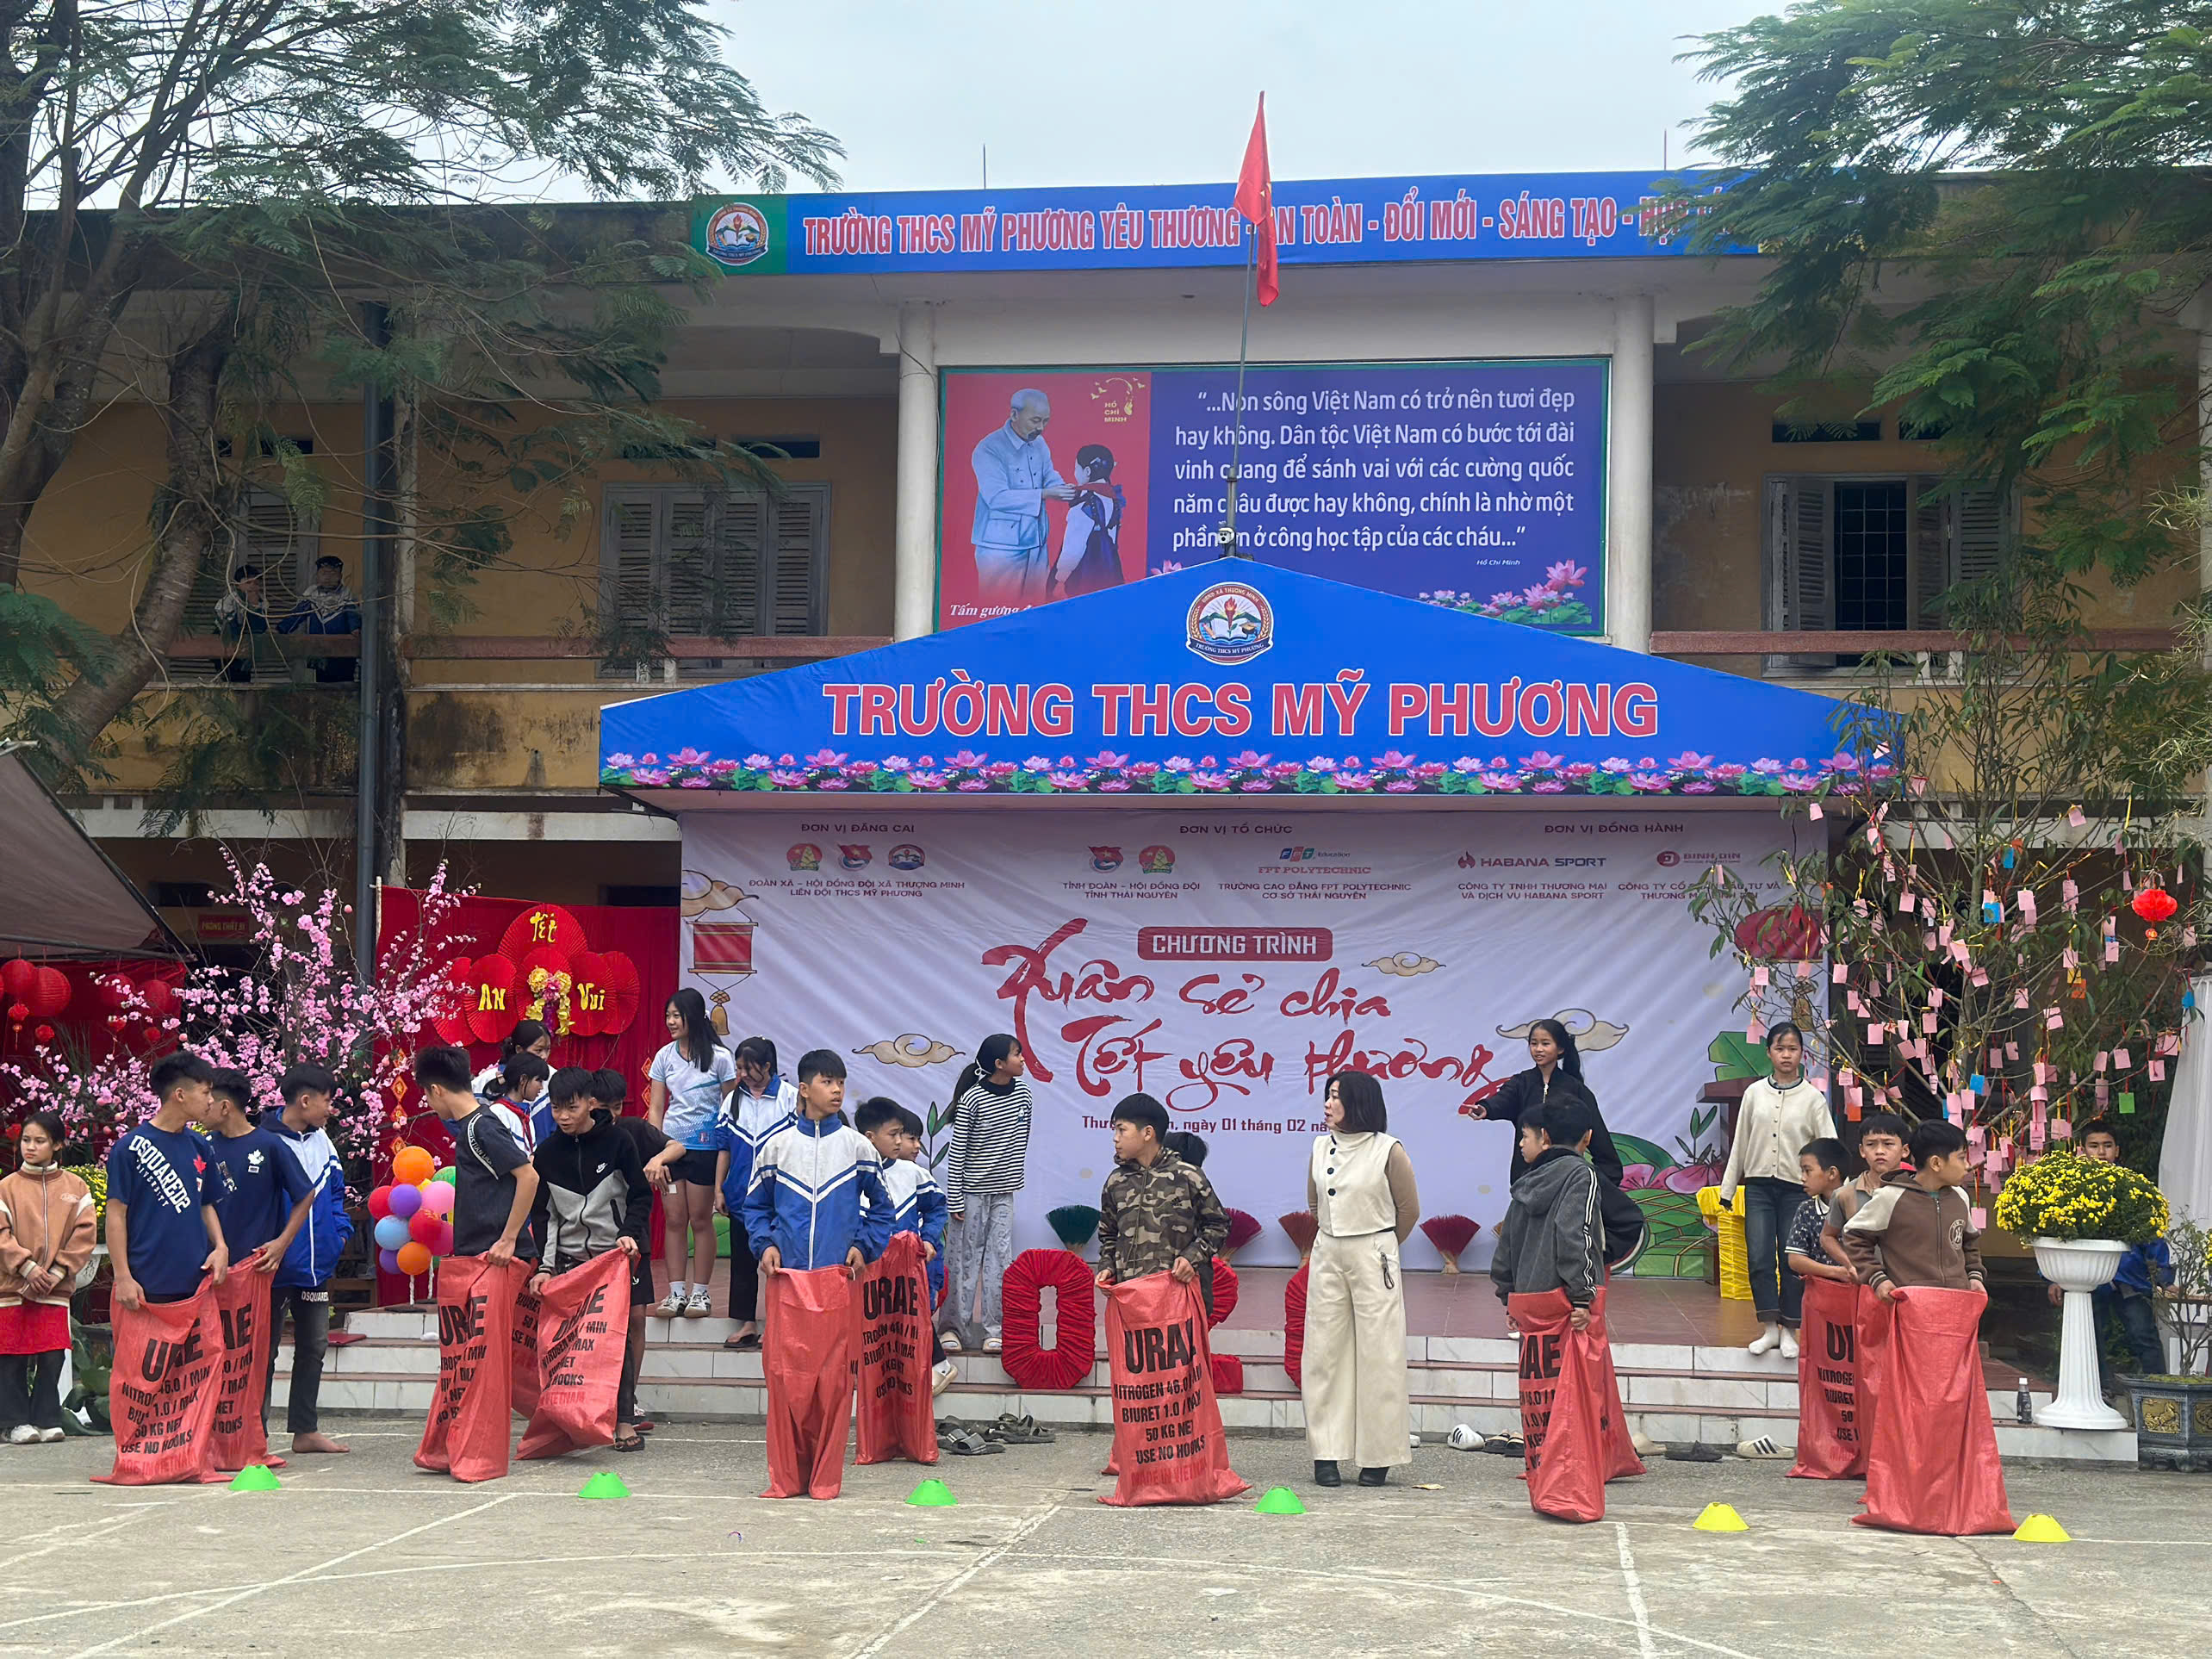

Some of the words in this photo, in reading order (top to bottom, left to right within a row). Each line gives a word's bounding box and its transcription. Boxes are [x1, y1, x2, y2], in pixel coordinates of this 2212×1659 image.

[804, 207, 892, 255] TRƯỜNG
[897, 214, 955, 253] THCS
[961, 206, 997, 252] MỸ
[1002, 205, 1094, 252] PHƯƠNG
[1100, 202, 1144, 249] YÊU
[1149, 203, 1240, 248] THƯƠNG
[1301, 196, 1363, 244] TOÀN
[1383, 186, 1424, 241] ĐỔI
[1431, 188, 1476, 240] MỚI
[1499, 190, 1564, 239] SÁNG
[1570, 197, 1617, 245] TẠO
[1263, 390, 1307, 414] sông
[1313, 390, 1349, 415] Việt
[1354, 391, 1395, 410] Nam
[1401, 389, 1420, 409] có
[1426, 388, 1454, 409] trở
[1458, 388, 1492, 408] nên
[1498, 388, 1533, 408] tươi
[1539, 388, 1575, 413] đẹp
[1176, 426, 1209, 450] hay
[1214, 425, 1275, 450] không.
[1281, 424, 1314, 445] Dân
[1320, 424, 1348, 450] tộc
[1353, 424, 1390, 449] Việt
[1395, 425, 1437, 444] Nam
[1442, 423, 1462, 443] có
[1468, 422, 1512, 443] bước
[1517, 422, 1541, 443] tới
[1546, 422, 1575, 443] đài
[1174, 459, 1213, 480] vinh
[1283, 454, 1307, 479] để
[1312, 457, 1356, 479] sánh
[1363, 458, 1389, 478] vai
[1396, 457, 1423, 478] với
[1430, 457, 1459, 478] các
[1466, 457, 1521, 482] cường
[1529, 454, 1575, 482] quốc
[1174, 494, 1212, 513] năm
[1265, 493, 1310, 518] được
[1314, 492, 1348, 518] hay
[1353, 492, 1415, 517] không,
[1420, 491, 1469, 513] chính
[1476, 491, 1490, 512] là
[1496, 491, 1532, 512] nhờ
[1537, 490, 1575, 517] một
[1173, 525, 1217, 552] phần
[1254, 525, 1266, 547] ở
[1269, 526, 1312, 552] công
[1317, 525, 1348, 552] học
[1352, 525, 1382, 552] tập
[1387, 525, 1418, 547] của
[1423, 526, 1452, 547] các
[950, 602, 979, 616] Tấm
[823, 669, 1073, 737] TRƯỜNG
[1091, 682, 1252, 737] THCS
[1271, 667, 1371, 736] MỸ
[1389, 676, 1658, 738] PHƯƠNG
[801, 823, 829, 832] ĐƠN
[835, 824, 846, 834] VỊ
[851, 823, 888, 832] ĐĂNG
[892, 824, 915, 833] CAI
[1179, 824, 1209, 834] ĐƠN
[1214, 825, 1226, 835] VỊ
[1254, 823, 1292, 834] CHỨC
[1544, 824, 1575, 833] ĐƠN
[1580, 825, 1593, 835] VỊ
[1644, 823, 1684, 833] HÀNH
[1279, 846, 1315, 862] FPT
[1481, 857, 1550, 867] HABANA
[1555, 857, 1607, 867] SPORT
[749, 879, 777, 887] ĐOÀN
[1089, 881, 1117, 890] ĐOÀN
[1183, 881, 1200, 891] ĐỘI
[1457, 881, 1488, 890] CÔNG
[1618, 881, 1650, 890] CÔNG
[1767, 880, 1780, 890] VÀ
[880, 889, 923, 898] PHƯƠNG
[1111, 891, 1134, 899] THÁI
[1136, 890, 1178, 899] NGUYÊN
[1299, 891, 1321, 900] THÁI
[1325, 891, 1367, 900] NGUYÊN
[1478, 892, 1503, 901] DỊCH
[1641, 892, 1686, 900] THƯƠNG
[1153, 933, 1246, 954] CHƯƠNG
[1252, 931, 1317, 954] TRÌNH
[981, 917, 1155, 1083] Xuân
[1280, 966, 1392, 1025] chia
[1060, 1015, 1174, 1097] Tết
[1165, 1037, 1275, 1112] yêu
[1184, 1119, 1217, 1134] ngày
[1222, 1118, 1237, 1130] 01
[1241, 1118, 1282, 1134] tháng
[1287, 1119, 1306, 1132] 02
[128, 1135, 191, 1214] DSQUARED2
[586, 1320, 607, 1334] MIN
[1124, 1316, 1196, 1375] URA
[1122, 1405, 1160, 1423] BIURET
[1164, 1401, 1180, 1418] 1.0
[150, 1422, 164, 1436] KG
[1146, 1427, 1159, 1442] 50
[1160, 1424, 1176, 1439] KG
[144, 1441, 159, 1454] NO
[162, 1429, 192, 1453] HOOKS
[1136, 1448, 1156, 1464] USE
[1159, 1445, 1174, 1462] NO
[1176, 1434, 1205, 1458] HOOKS
